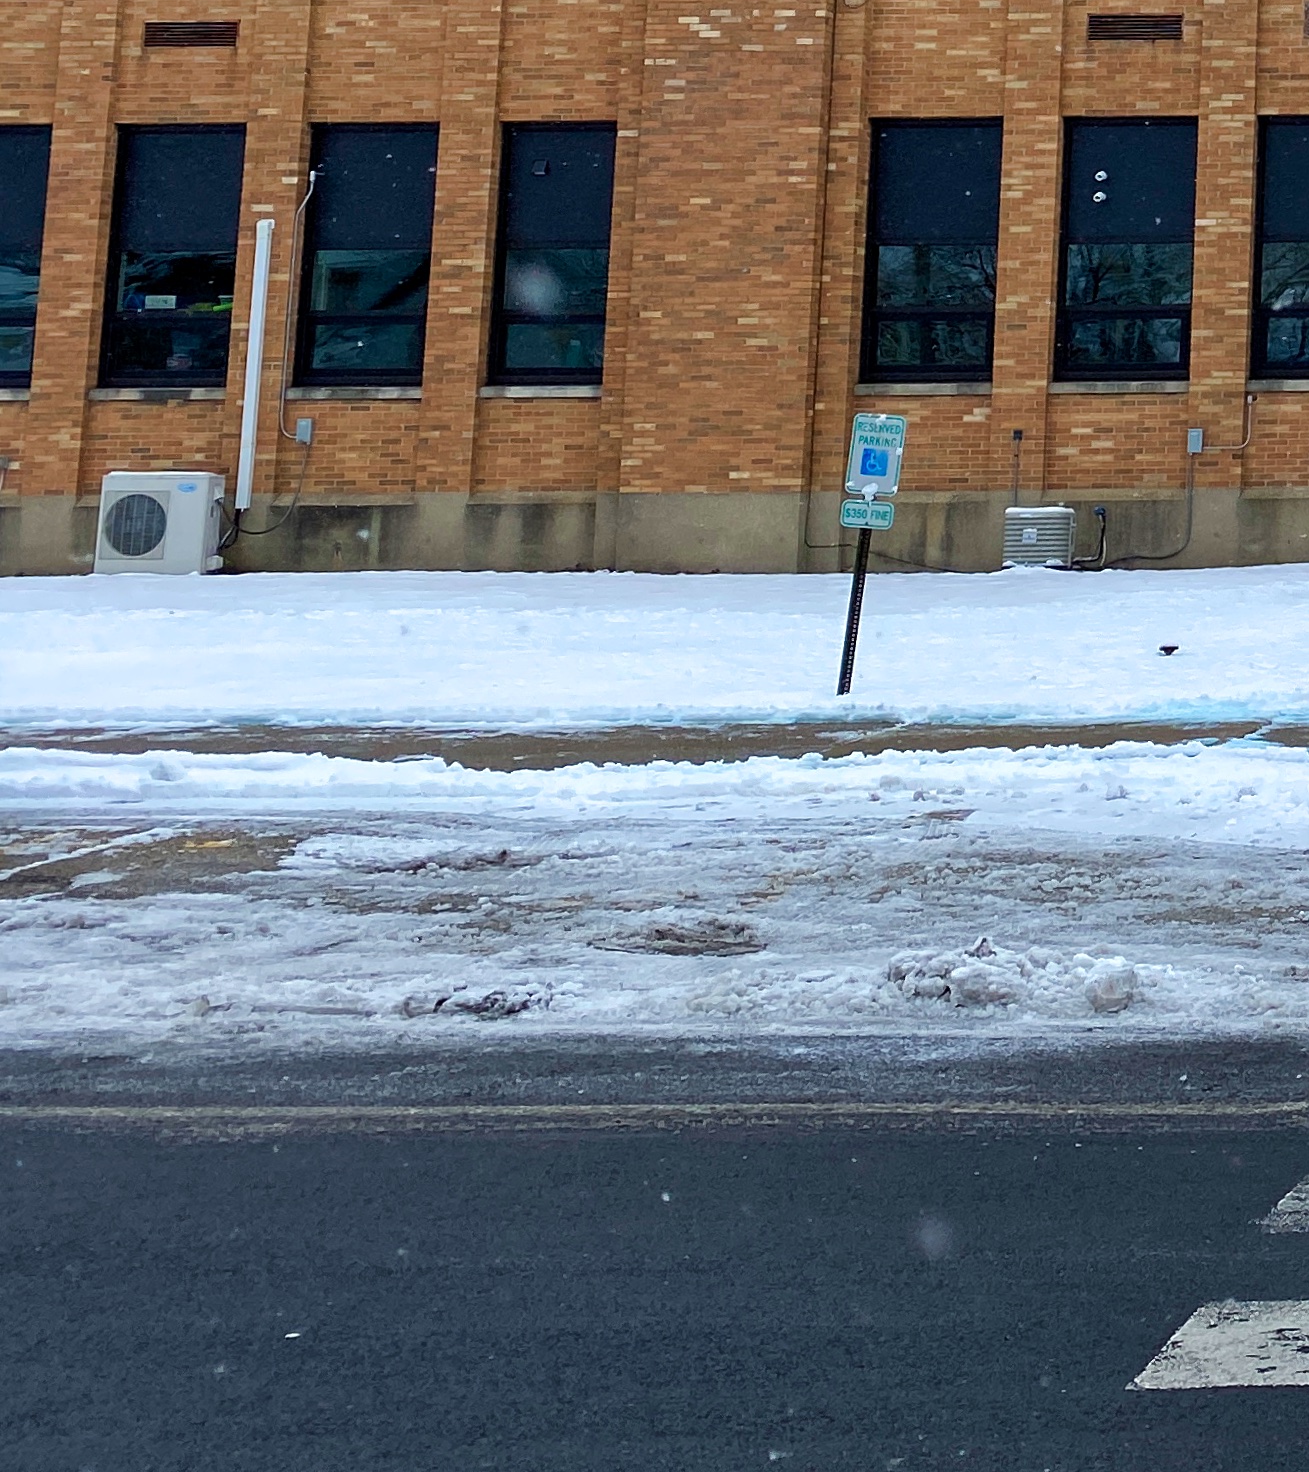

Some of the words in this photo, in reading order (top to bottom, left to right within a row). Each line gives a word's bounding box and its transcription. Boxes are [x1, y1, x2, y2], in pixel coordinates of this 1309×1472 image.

[857, 421, 901, 435] RESERVED
[858, 434, 897, 448] PARKING
[845, 507, 868, 519] $350
[870, 509, 889, 521] FINE
